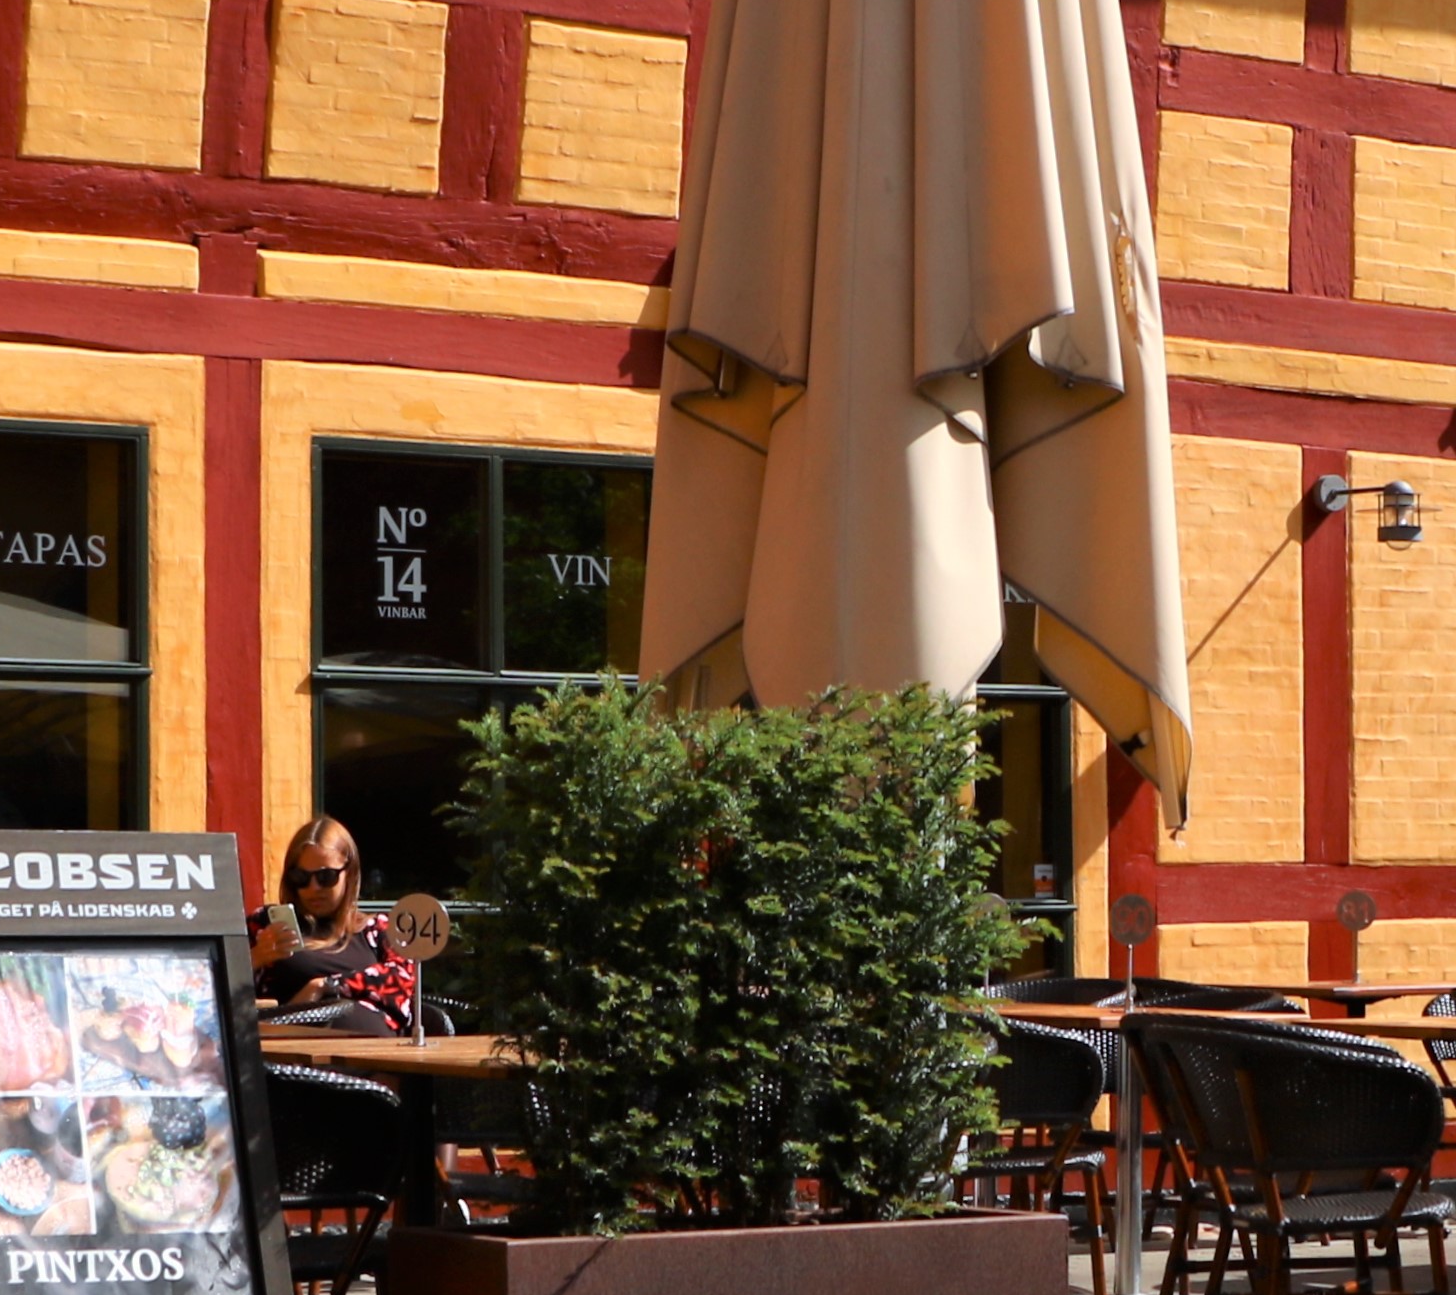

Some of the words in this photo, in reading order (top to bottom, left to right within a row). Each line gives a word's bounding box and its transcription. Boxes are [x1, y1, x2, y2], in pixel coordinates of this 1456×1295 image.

[376, 555, 427, 603] 14
[547, 553, 613, 587] VIN
[377, 605, 427, 620] VINBAR
[38, 900, 65, 918] PÅ
[67, 903, 176, 918] LIDENSKAB
[395, 910, 442, 946] 94
[7, 1247, 185, 1285] PINTXOS
